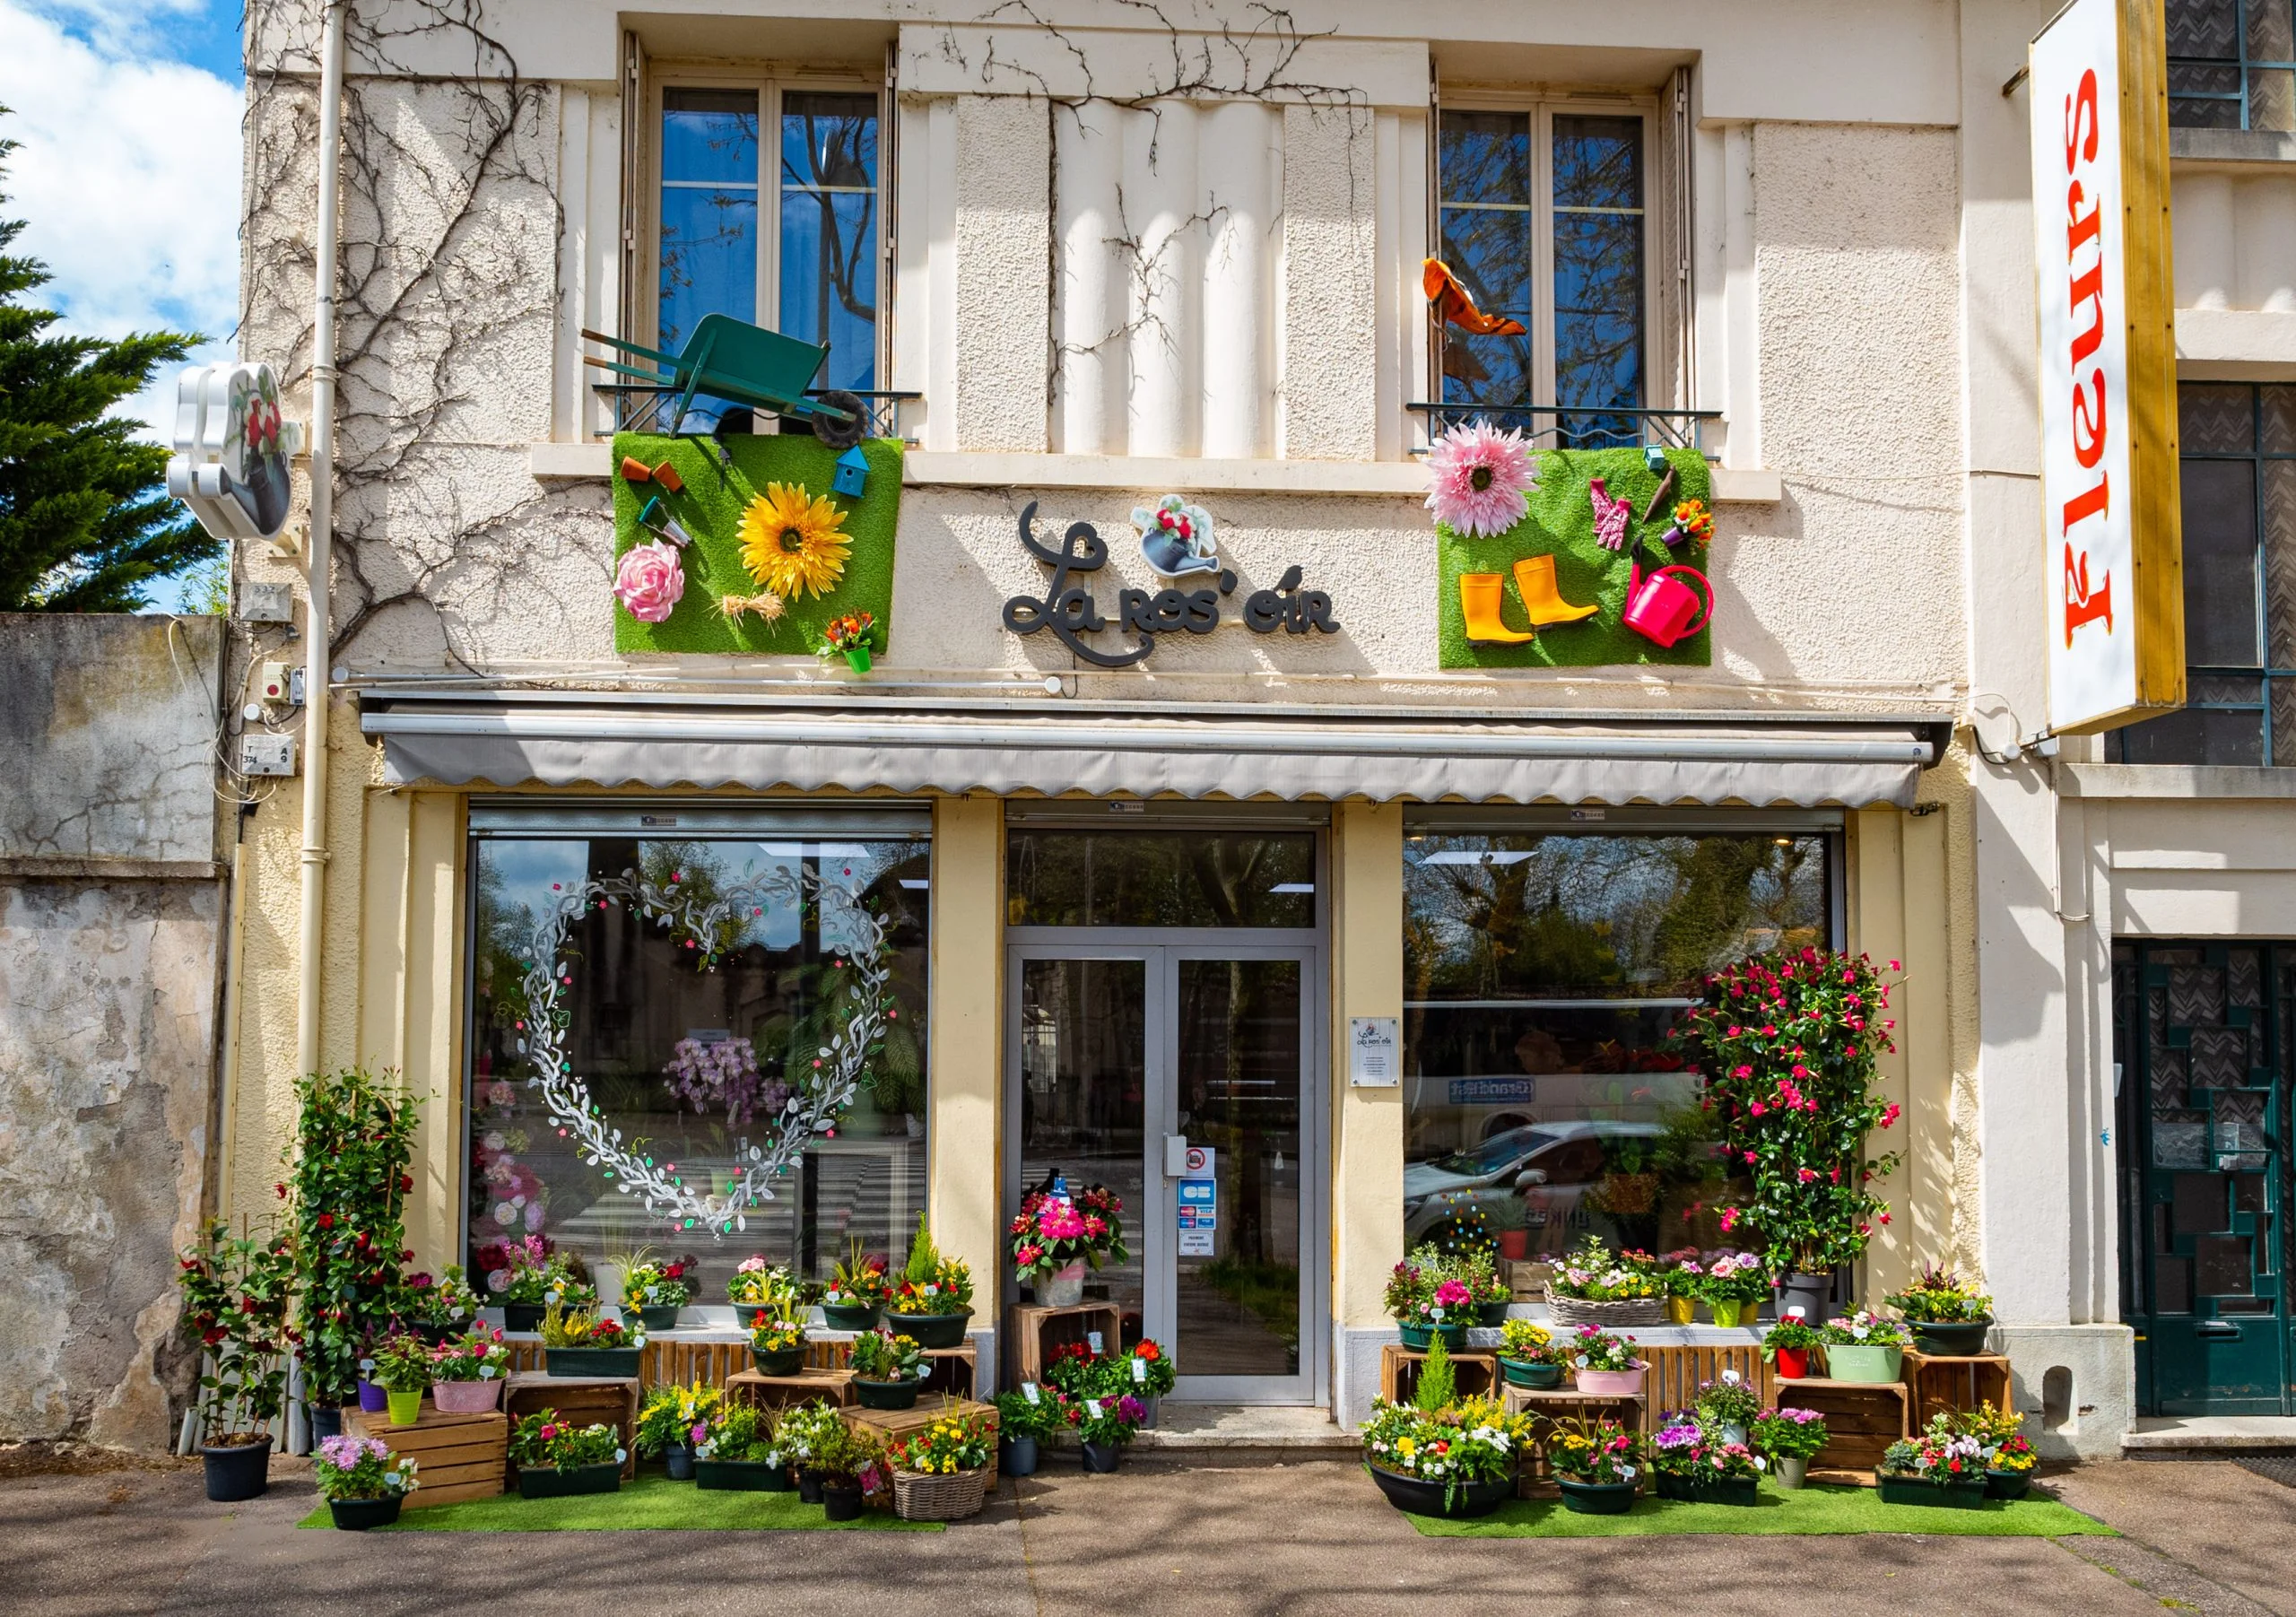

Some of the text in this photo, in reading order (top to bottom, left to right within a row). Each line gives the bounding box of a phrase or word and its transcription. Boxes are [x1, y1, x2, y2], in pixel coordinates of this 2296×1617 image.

[2062, 68, 2113, 649] Fleurs
[1003, 500, 1154, 666] La
[1183, 1186, 1211, 1198] CB
